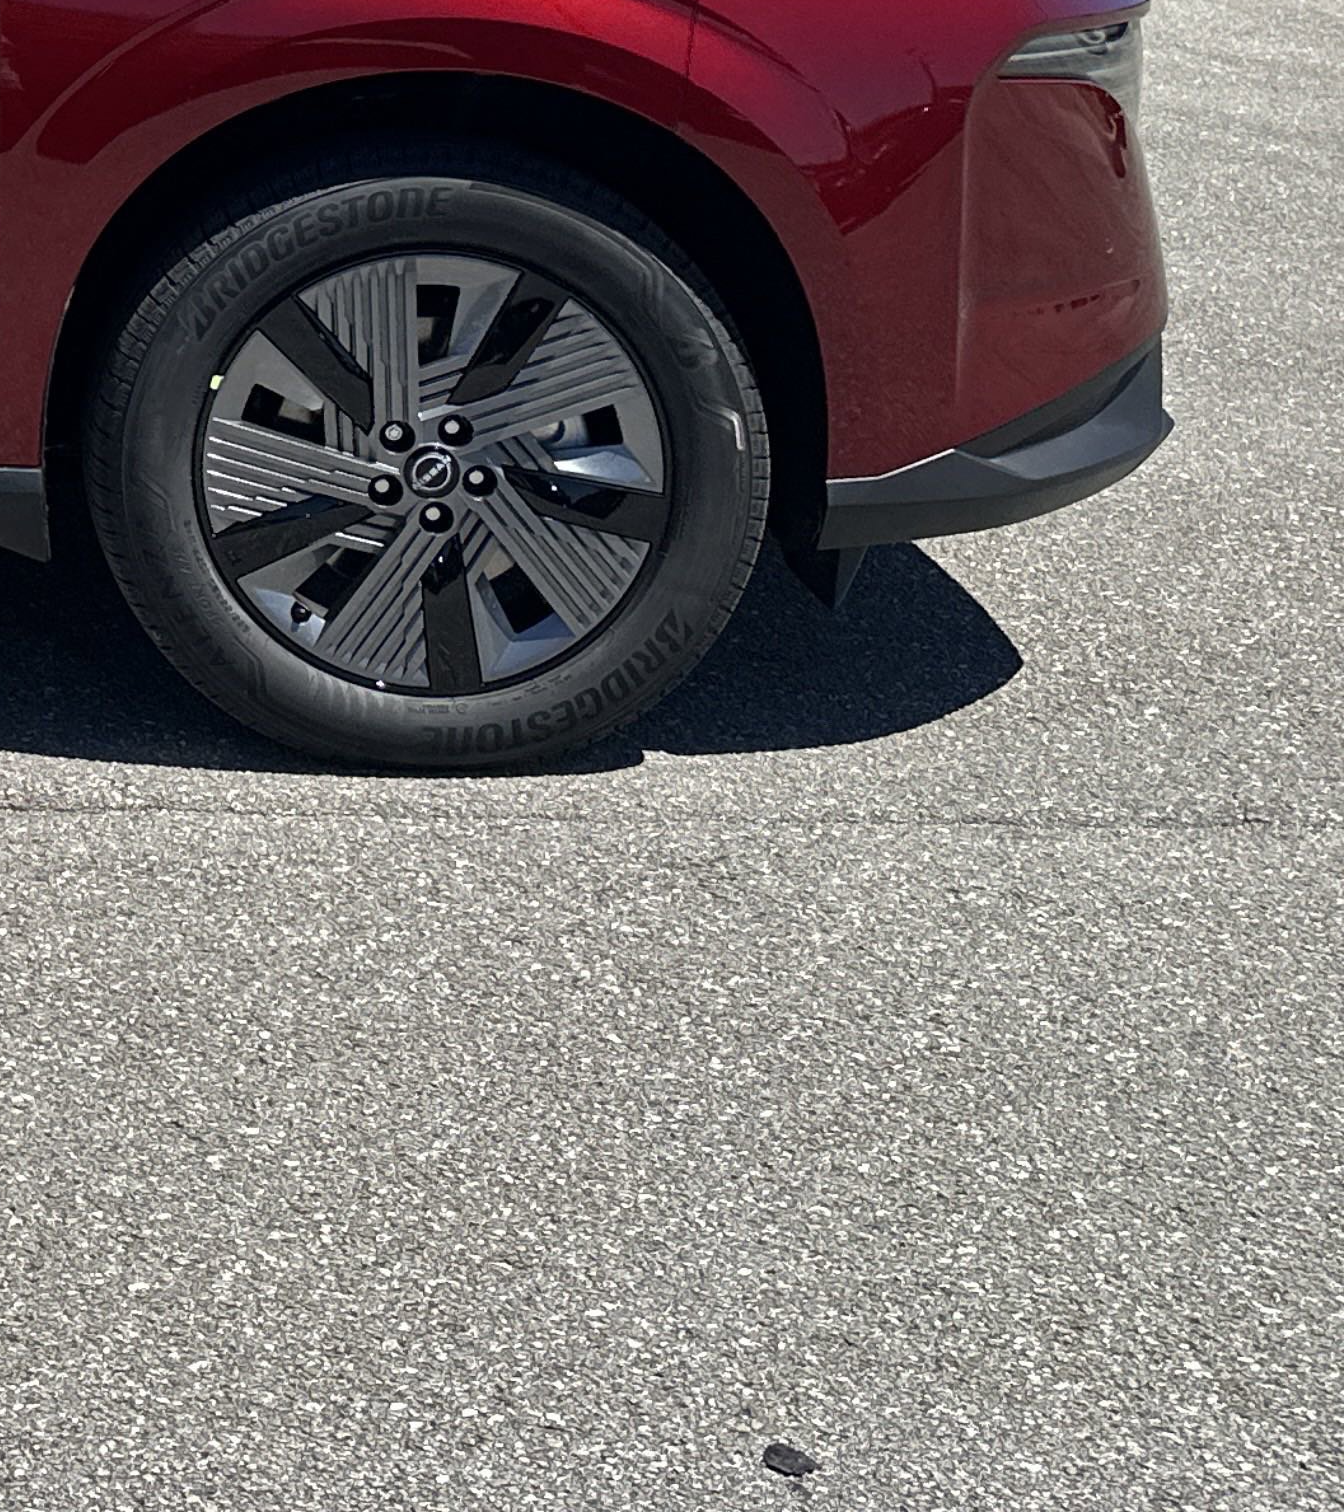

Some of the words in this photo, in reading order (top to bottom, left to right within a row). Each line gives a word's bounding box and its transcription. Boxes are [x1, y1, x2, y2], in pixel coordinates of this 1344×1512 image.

[178, 187, 453, 342] BRIDGESTONE
[413, 454, 452, 490] NISSAN
[422, 606, 694, 753] BRIDGESTONE
